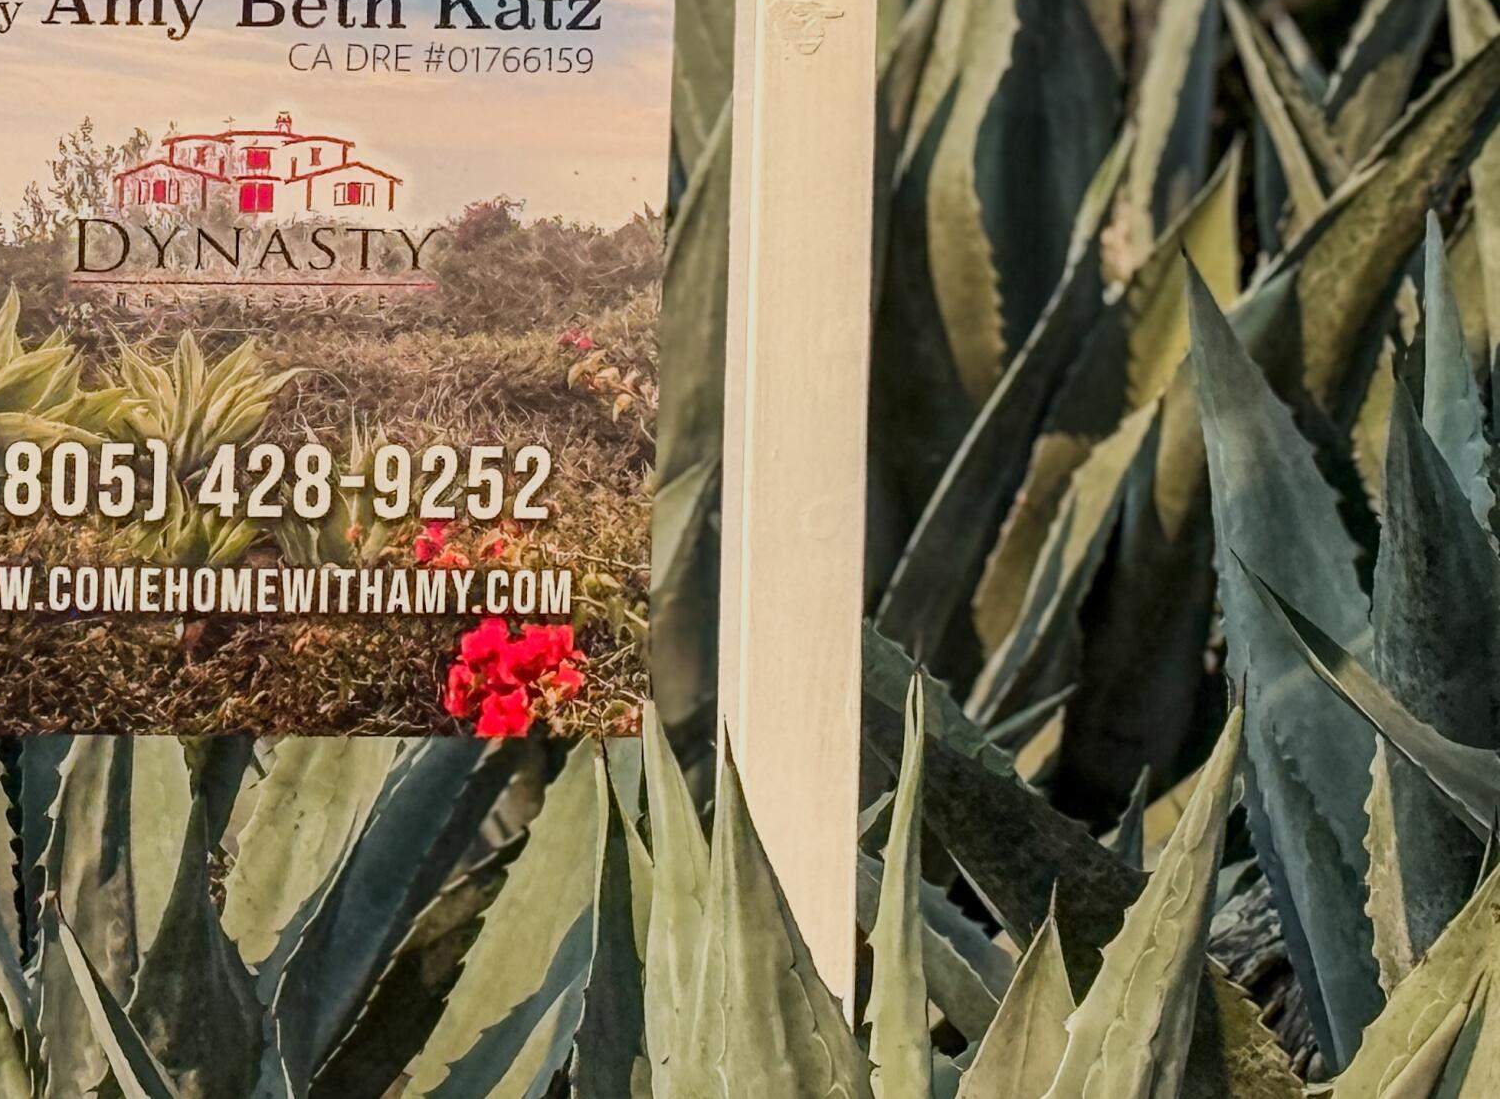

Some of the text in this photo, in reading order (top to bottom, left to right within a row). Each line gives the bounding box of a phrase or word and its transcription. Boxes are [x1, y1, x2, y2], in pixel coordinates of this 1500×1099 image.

[288, 42, 595, 75] CA DRE #01766159
[73, 218, 443, 274] DYNASTY
[197, 442, 553, 521] 428-9252
